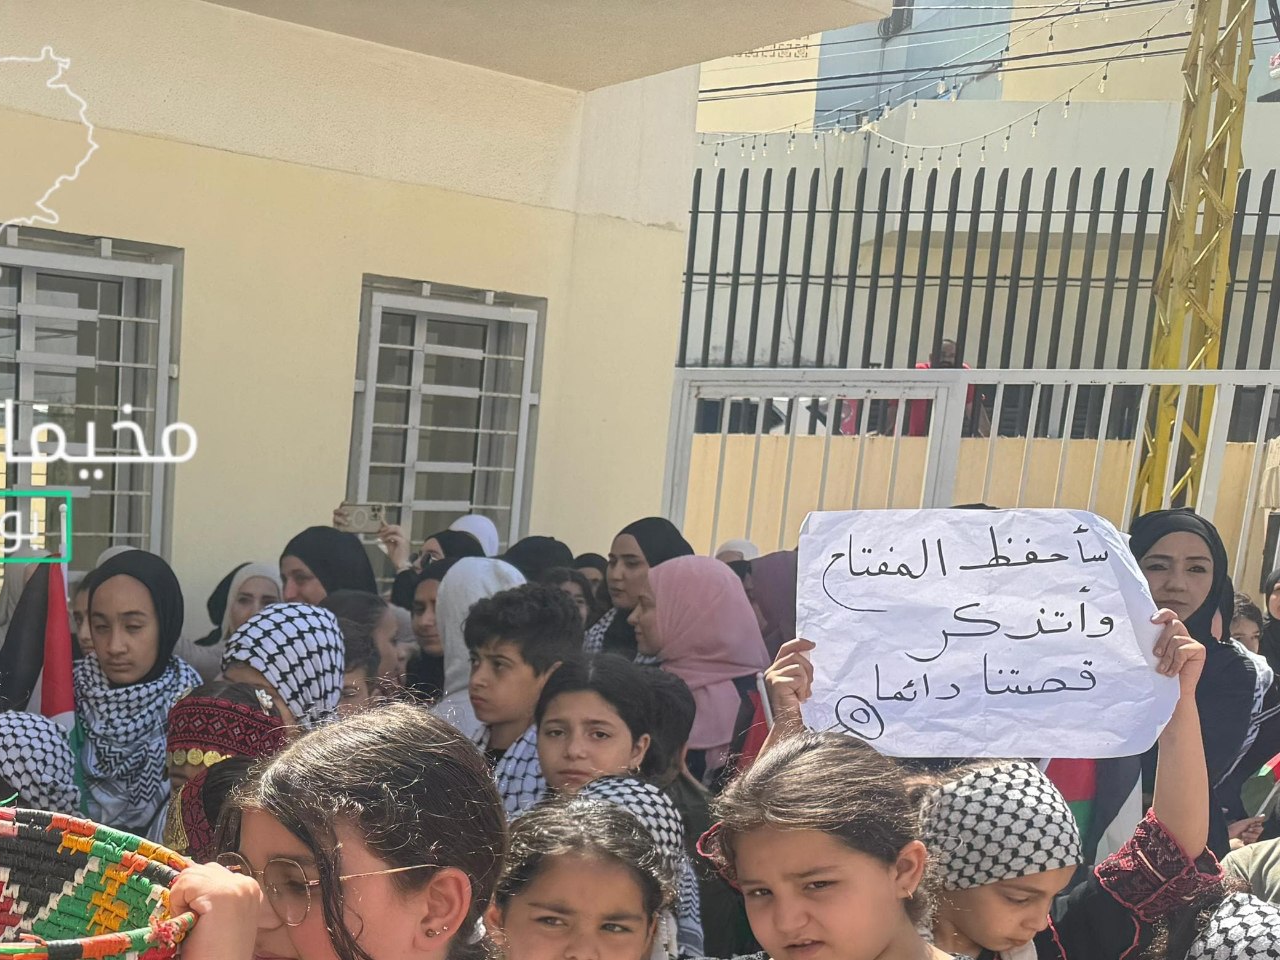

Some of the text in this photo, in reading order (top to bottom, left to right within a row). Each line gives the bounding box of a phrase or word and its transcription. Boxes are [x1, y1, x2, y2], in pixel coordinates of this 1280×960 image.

[822, 533, 947, 613] المفتاح
[874, 652, 1098, 702] قصتنا دائما
